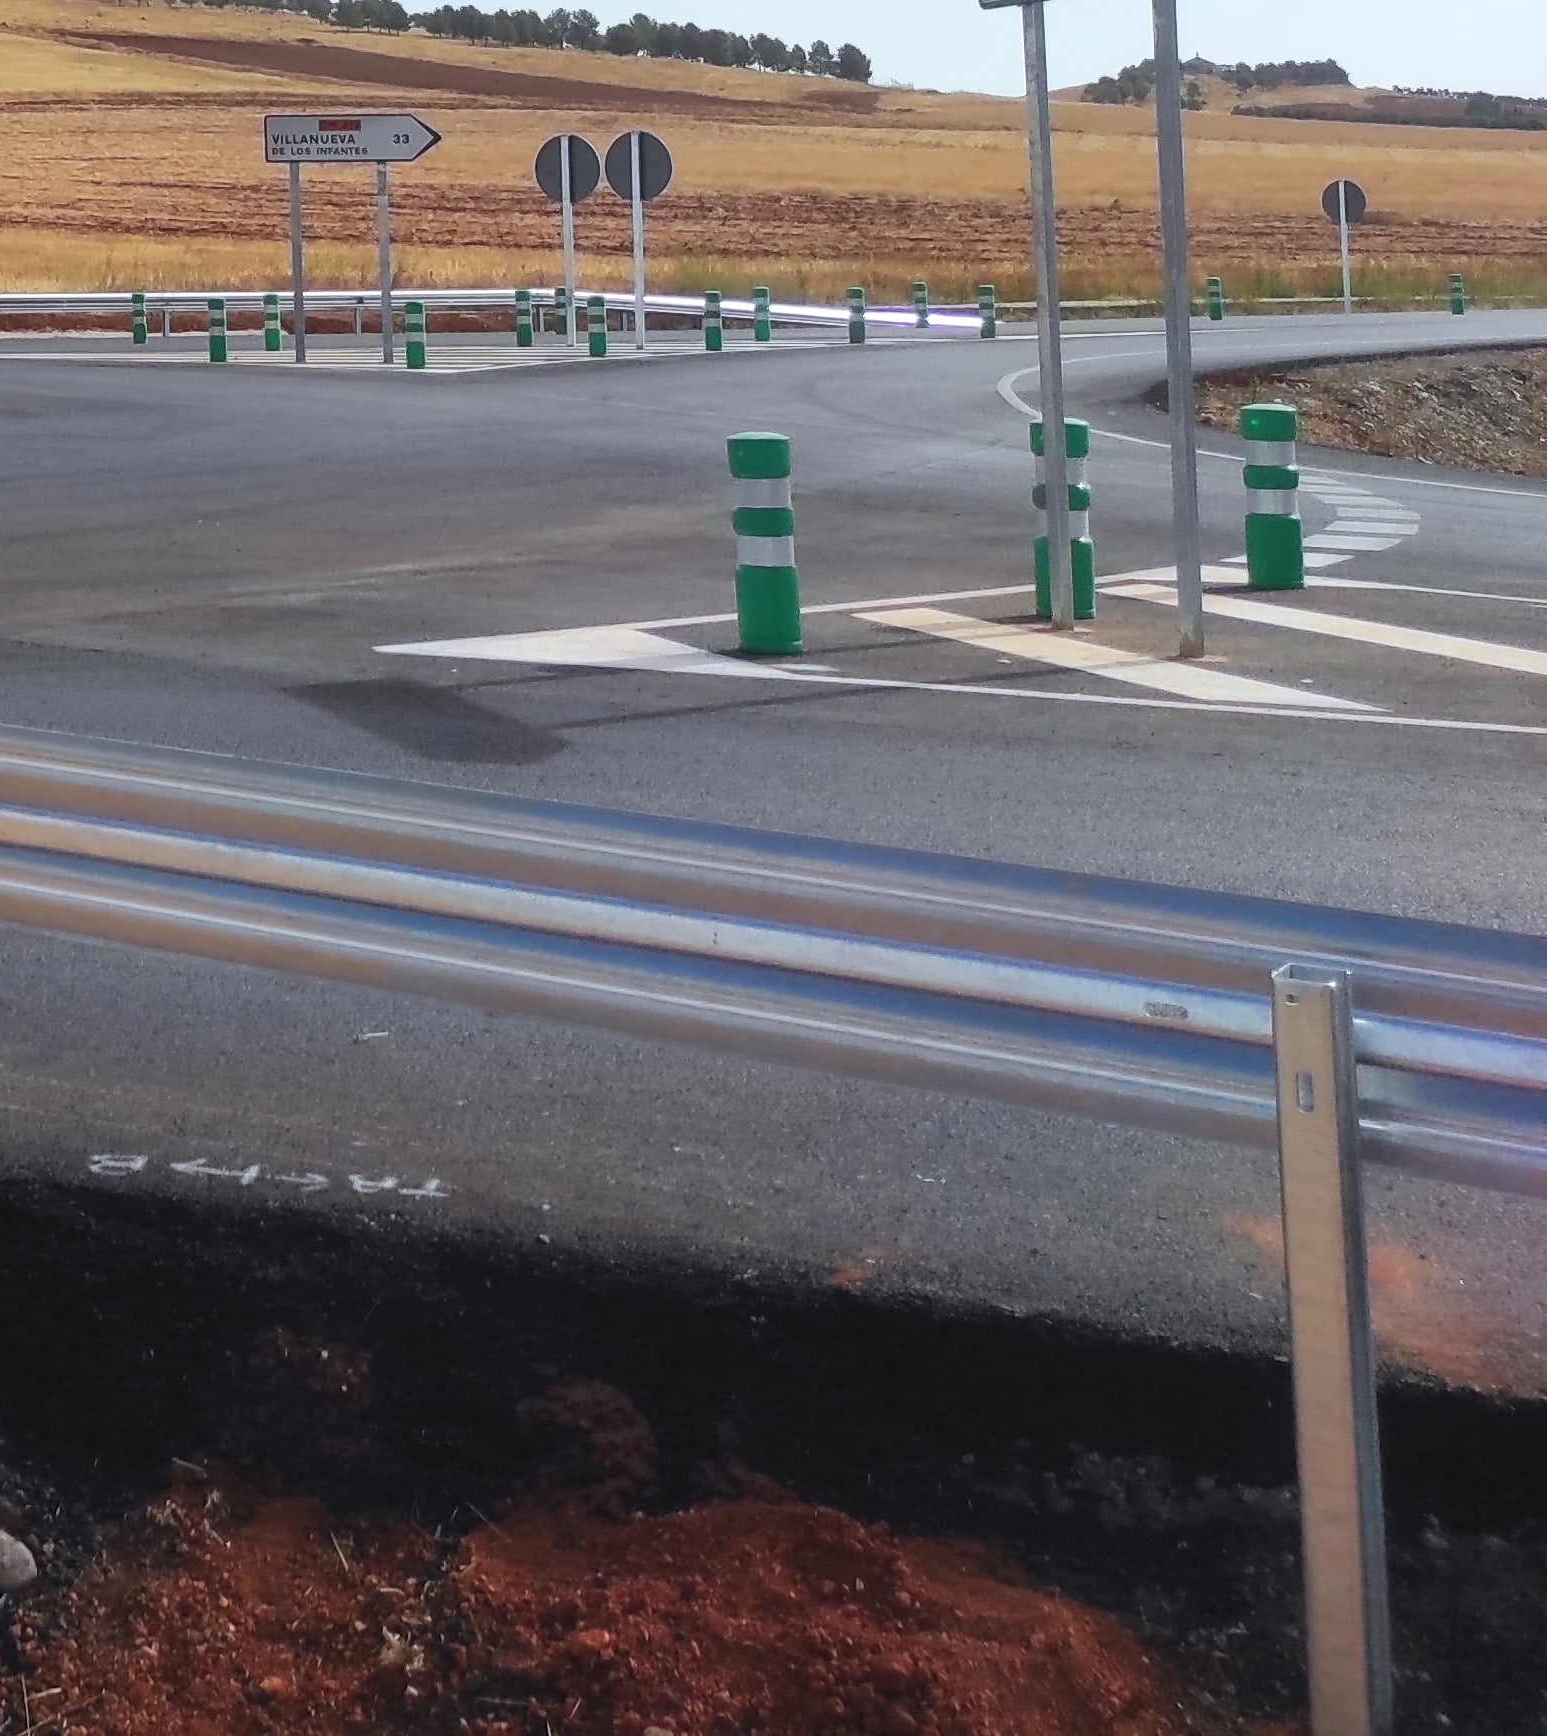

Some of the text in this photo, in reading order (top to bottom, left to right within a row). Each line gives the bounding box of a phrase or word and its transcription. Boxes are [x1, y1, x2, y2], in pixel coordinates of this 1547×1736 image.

[271, 133, 410, 145] VILLANUEVA 33
[271, 146, 369, 156] DE LOS INFANTES
